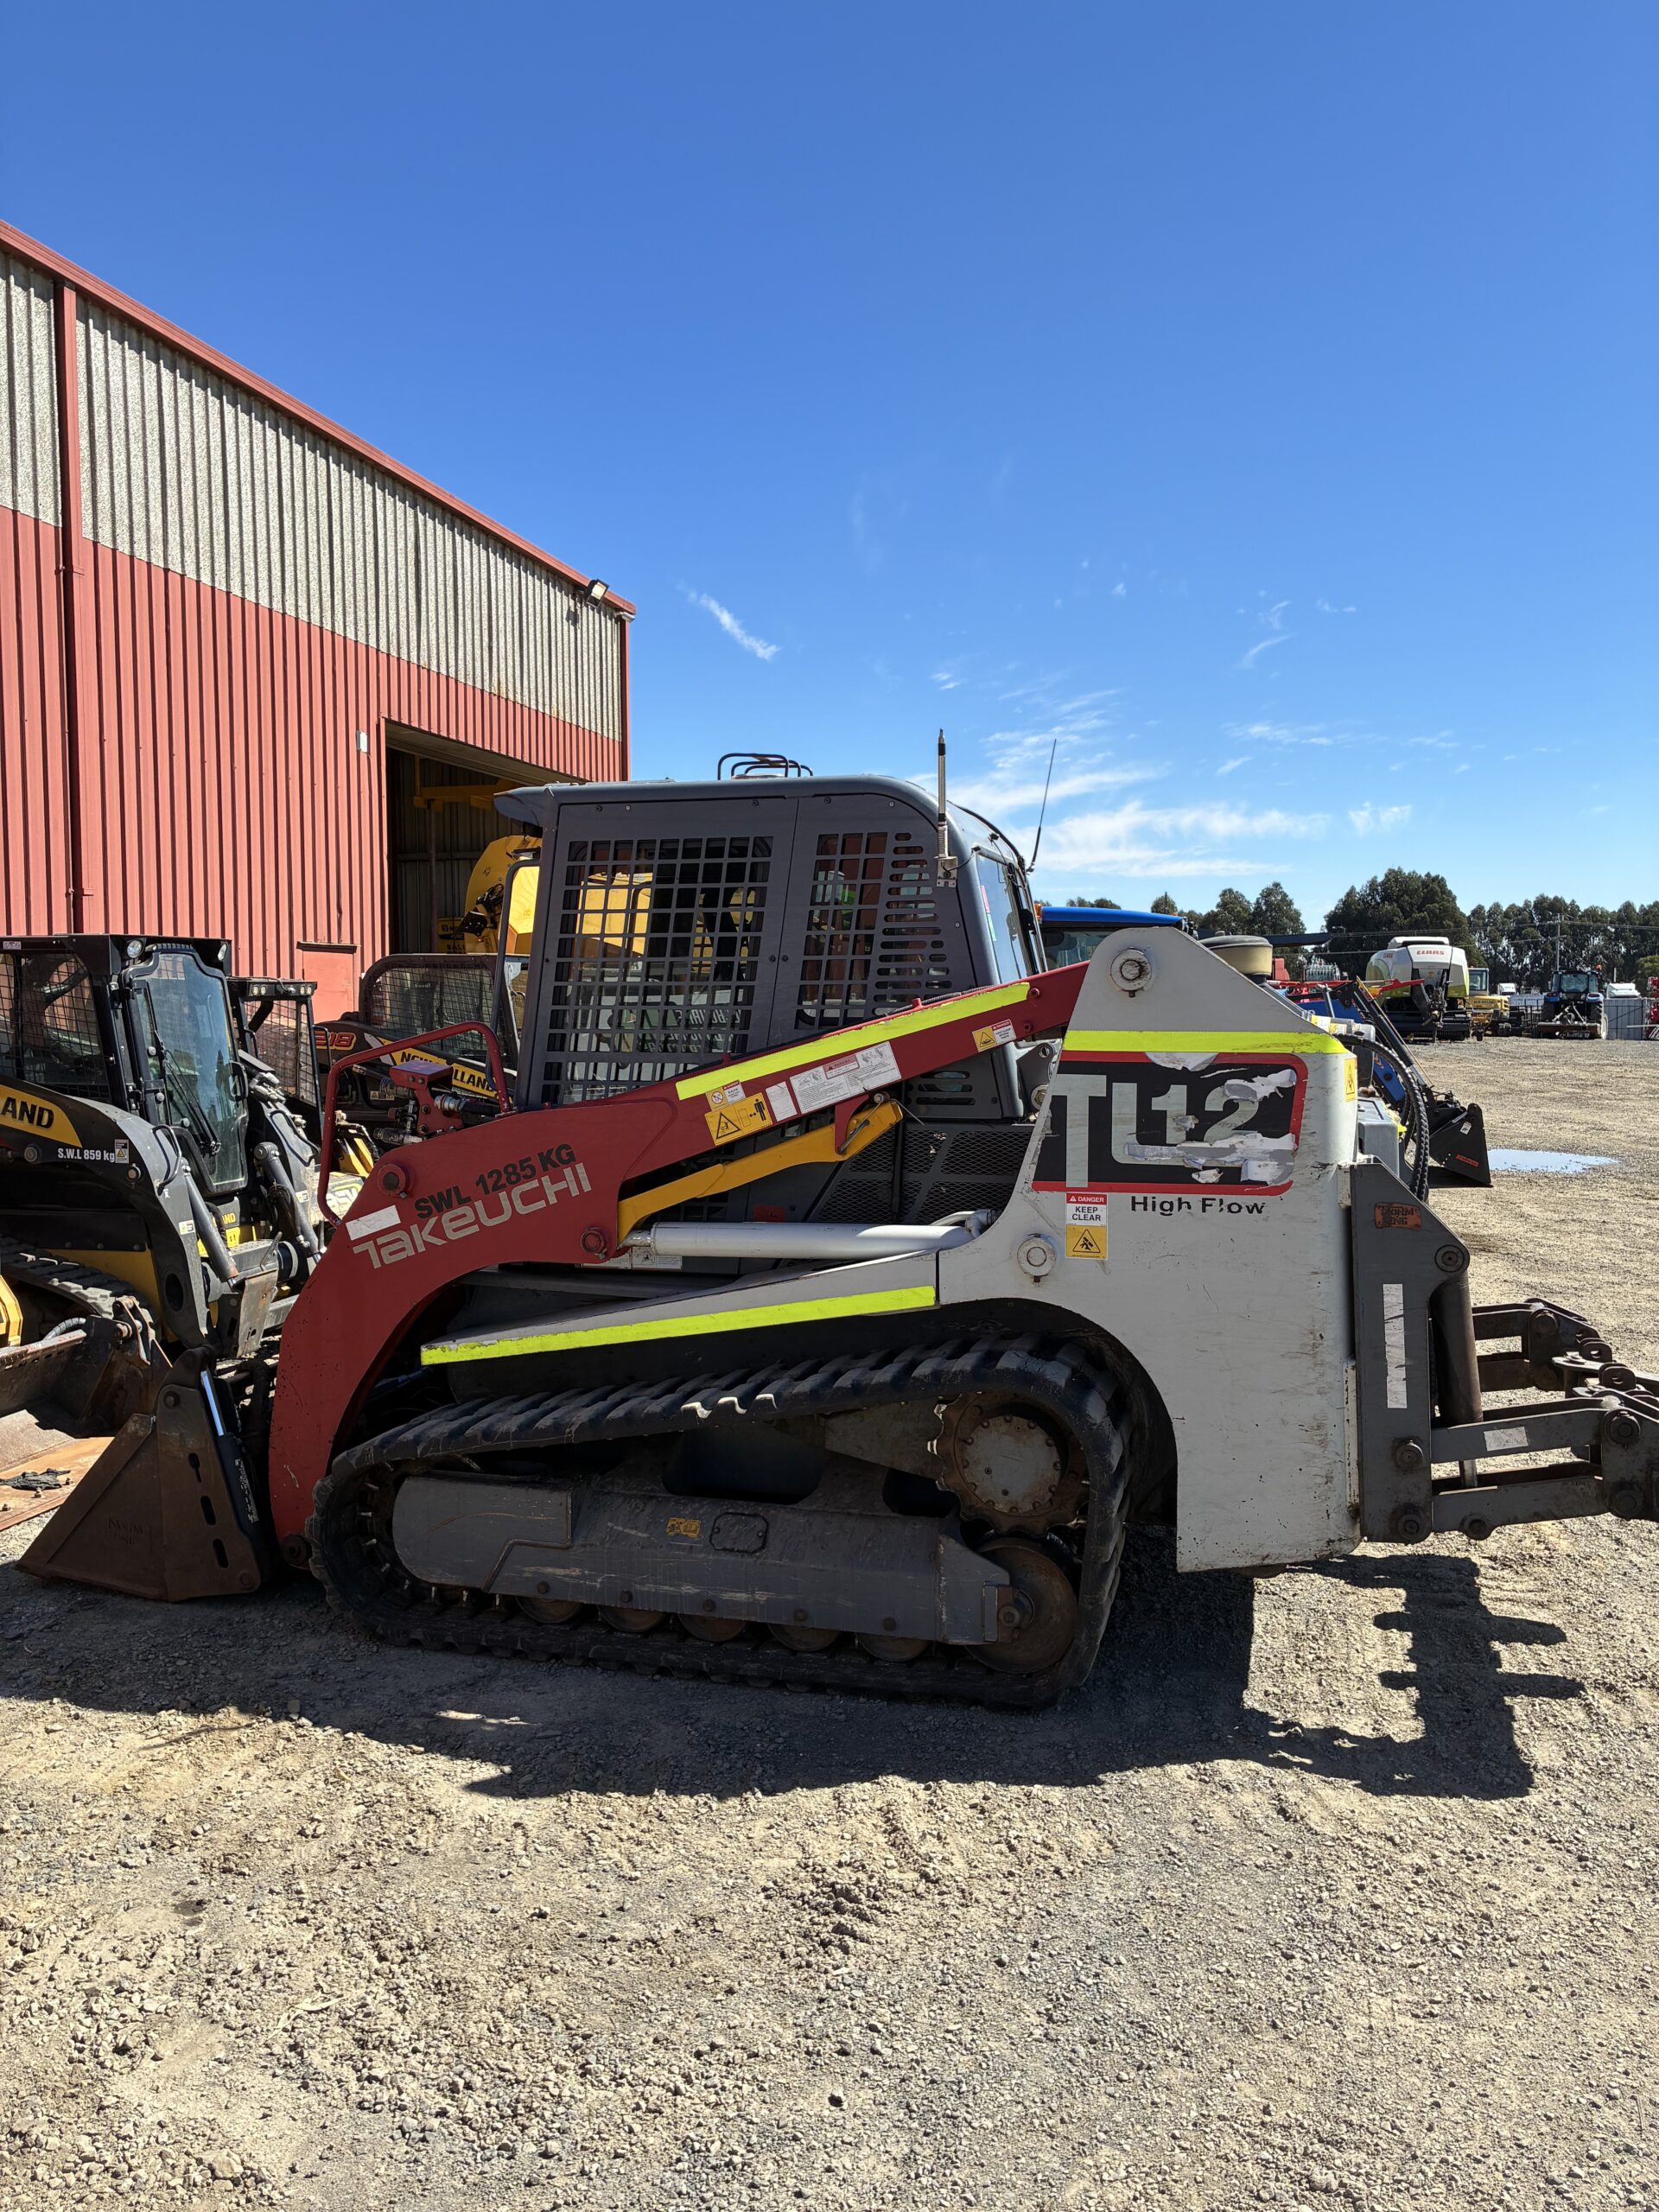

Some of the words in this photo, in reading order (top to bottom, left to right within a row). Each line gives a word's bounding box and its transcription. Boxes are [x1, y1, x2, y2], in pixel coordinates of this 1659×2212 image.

[57, 1147, 82, 1160] S.W.L
[83, 1149, 102, 1161] 859
[103, 1150, 116, 1162] kg
[414, 1185, 472, 1219] SWL
[475, 1156, 537, 1195] 1285
[537, 1142, 577, 1173] KG
[1075, 1205, 1098, 1214] KEEP
[1130, 1196, 1192, 1217] High
[1201, 1198, 1266, 1215] Flow
[1071, 1213, 1102, 1222] CLEAR
